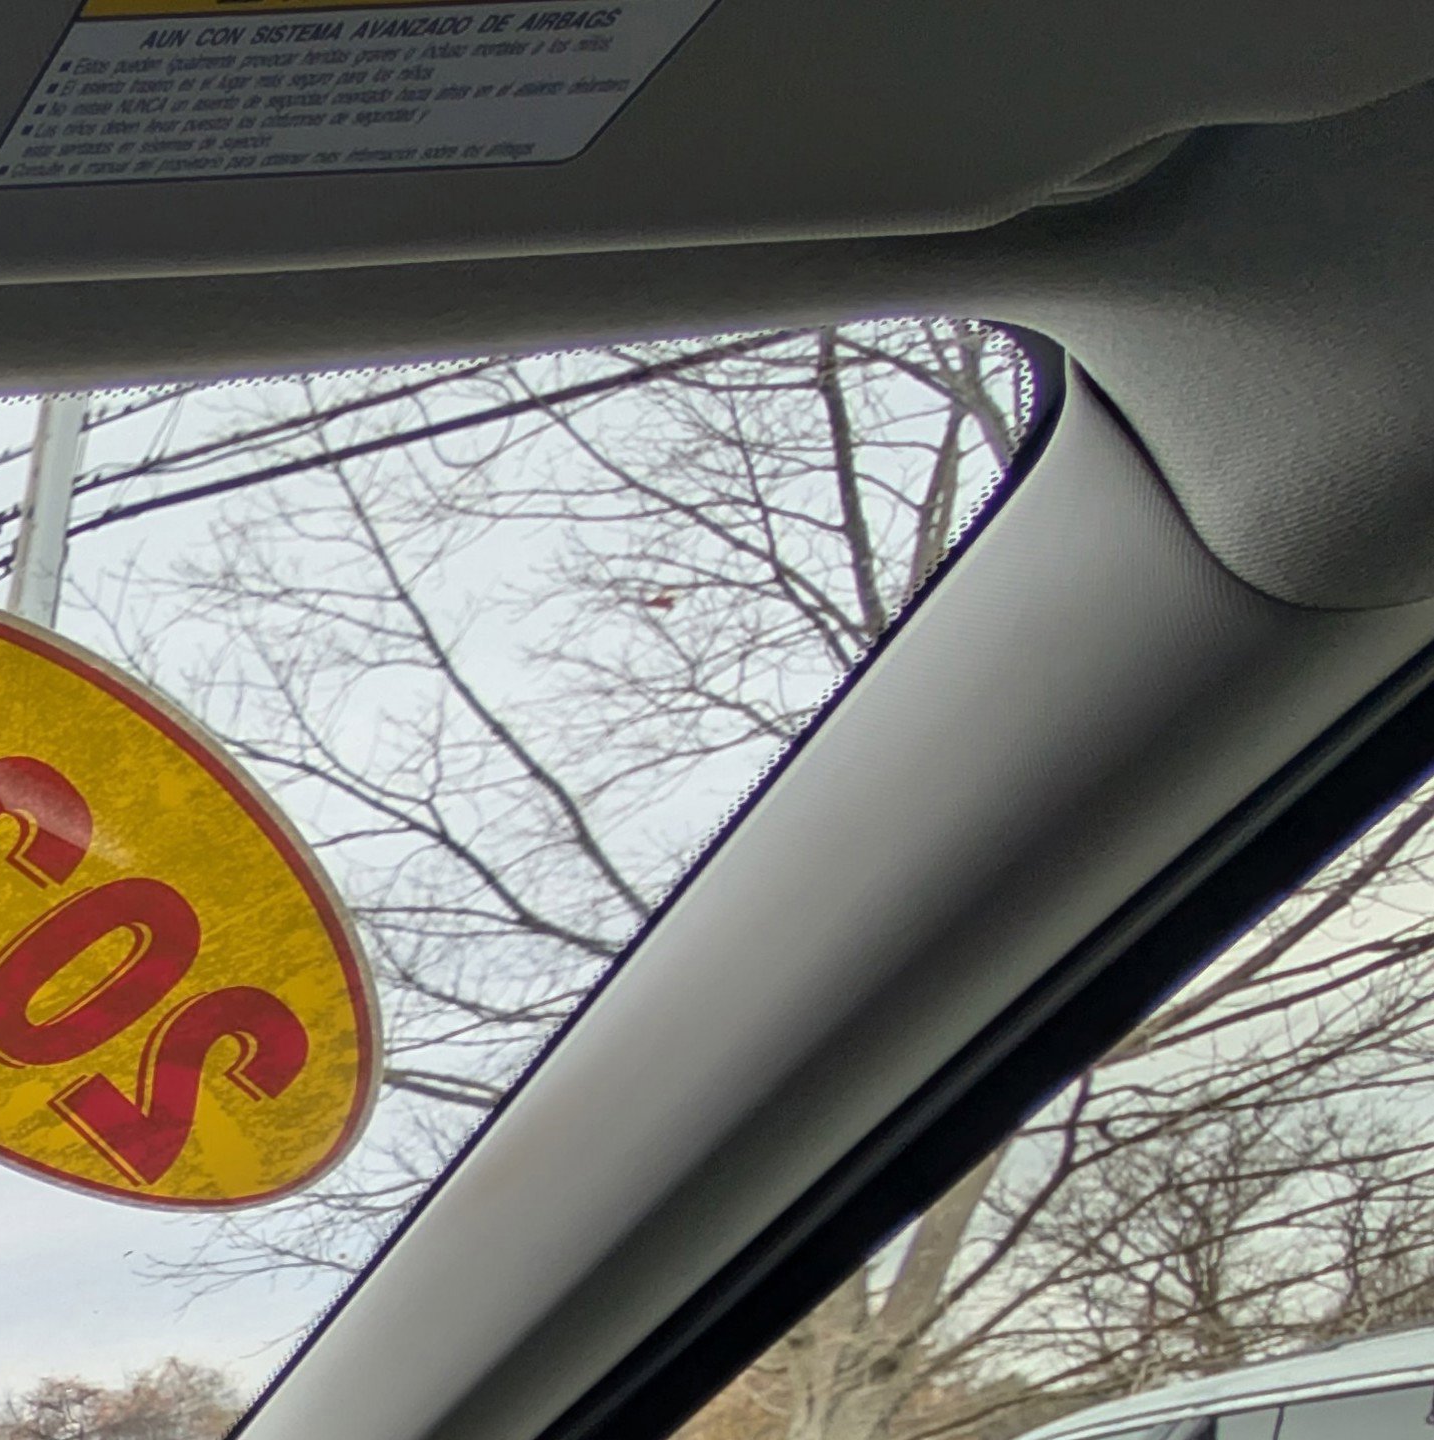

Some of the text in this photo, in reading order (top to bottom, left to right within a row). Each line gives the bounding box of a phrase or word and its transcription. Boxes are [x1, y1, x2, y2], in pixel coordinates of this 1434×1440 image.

[138, 8, 624, 49] AUN CON SISTEMA AVANZADO DE AIRBAGS
